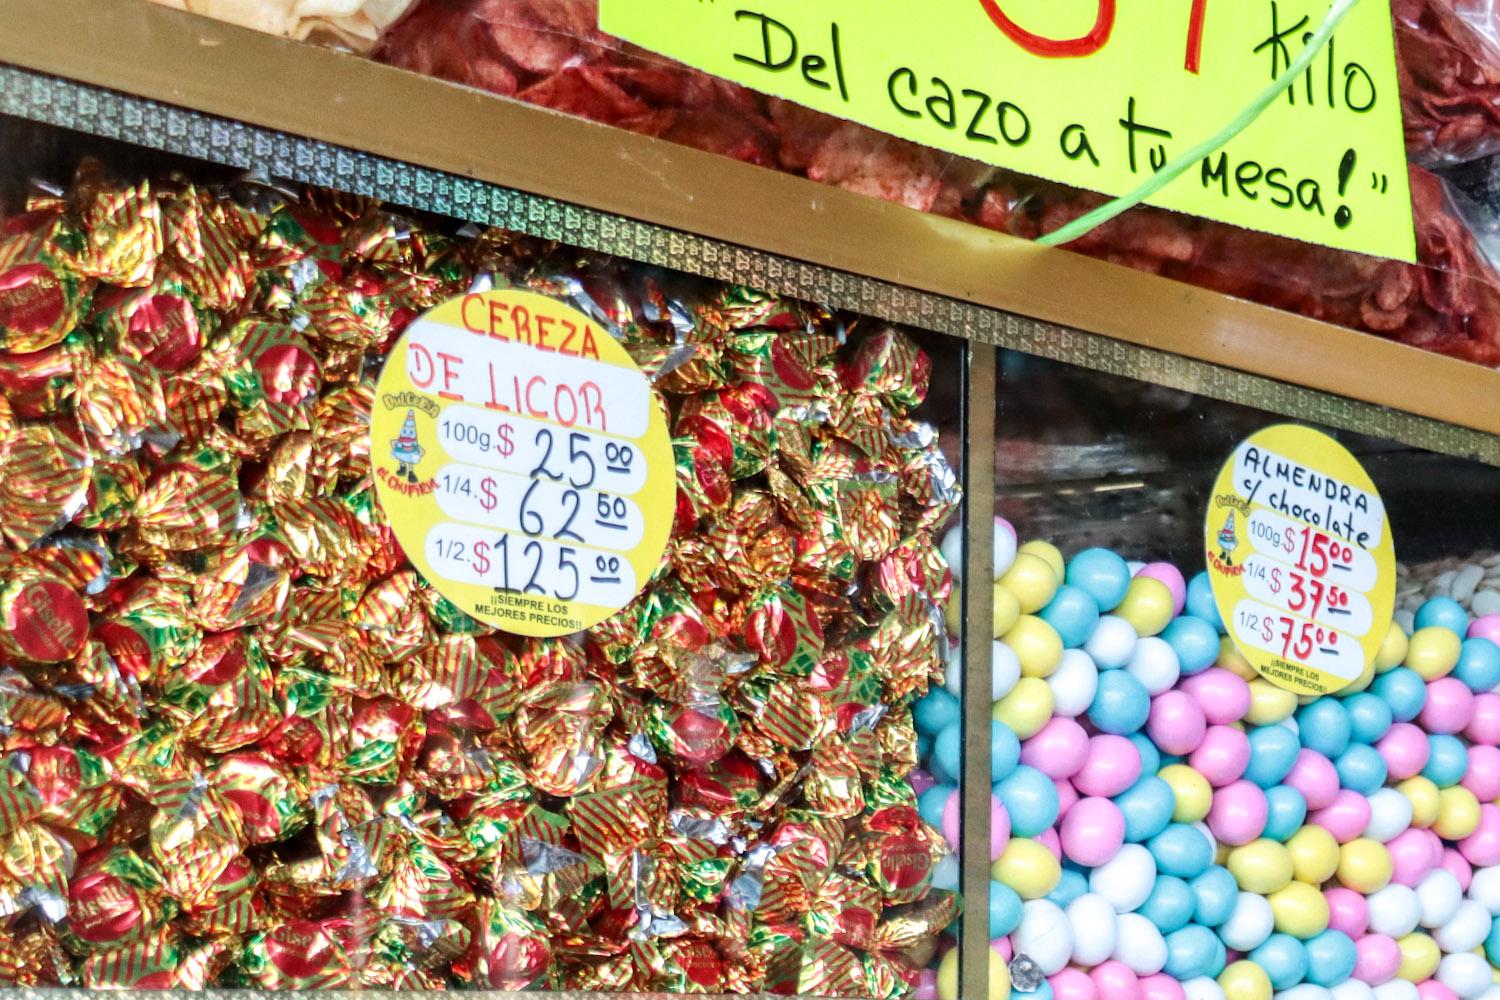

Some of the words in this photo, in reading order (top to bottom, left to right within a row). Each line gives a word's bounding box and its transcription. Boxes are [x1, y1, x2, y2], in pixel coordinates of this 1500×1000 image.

[887, 66, 1032, 147] cazo
[1060, 123, 1100, 167] a
[1119, 96, 1173, 174] tu
[461, 293, 600, 360] CEREZA
[409, 342, 464, 401] DE
[485, 362, 606, 432] LICOR
[1243, 447, 1369, 514] ALMENDRA
[1269, 488, 1370, 550] chocolate
[475, 604, 526, 620] MEJORES
[547, 603, 568, 615] LOS
[1261, 664, 1292, 682] MEJORES
[1306, 671, 1320, 681] LOS
